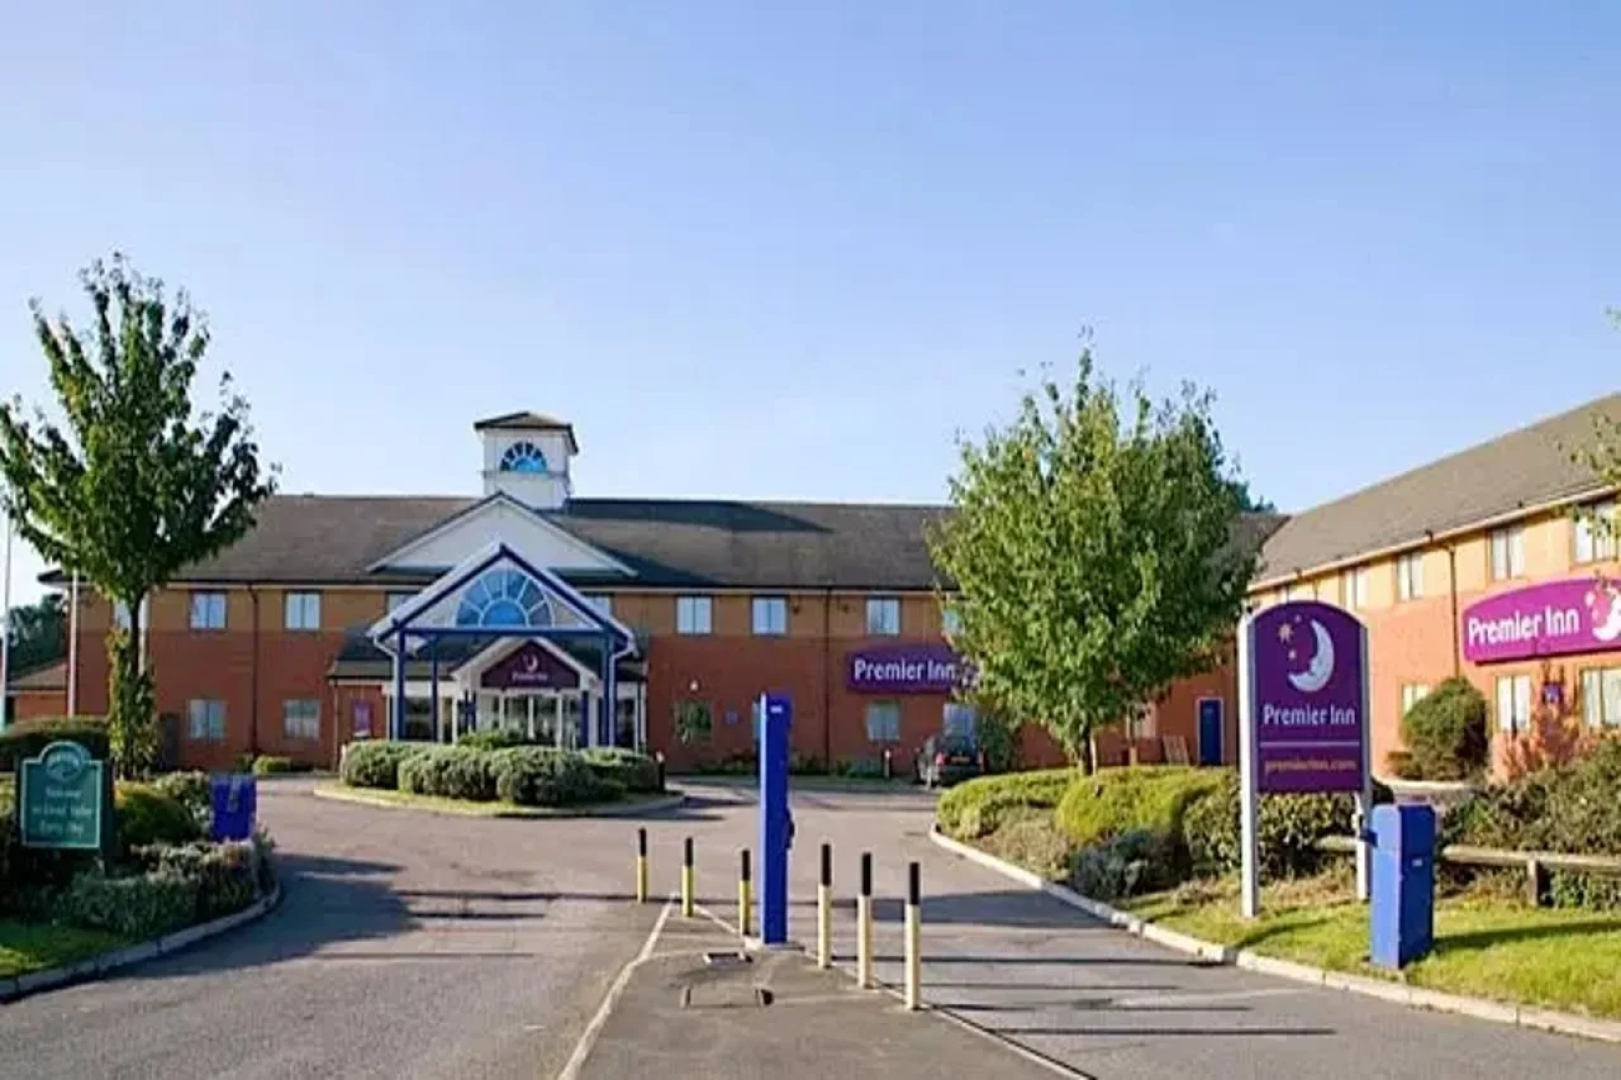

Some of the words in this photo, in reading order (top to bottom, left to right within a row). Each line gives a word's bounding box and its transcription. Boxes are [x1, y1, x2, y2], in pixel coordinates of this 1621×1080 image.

[1468, 610, 1542, 646] Premier
[1545, 604, 1579, 637] Inn
[854, 658, 925, 680] Premier
[927, 659, 956, 680] Inn
[1263, 703, 1328, 725] Premier
[1330, 703, 1355, 725] Inn
